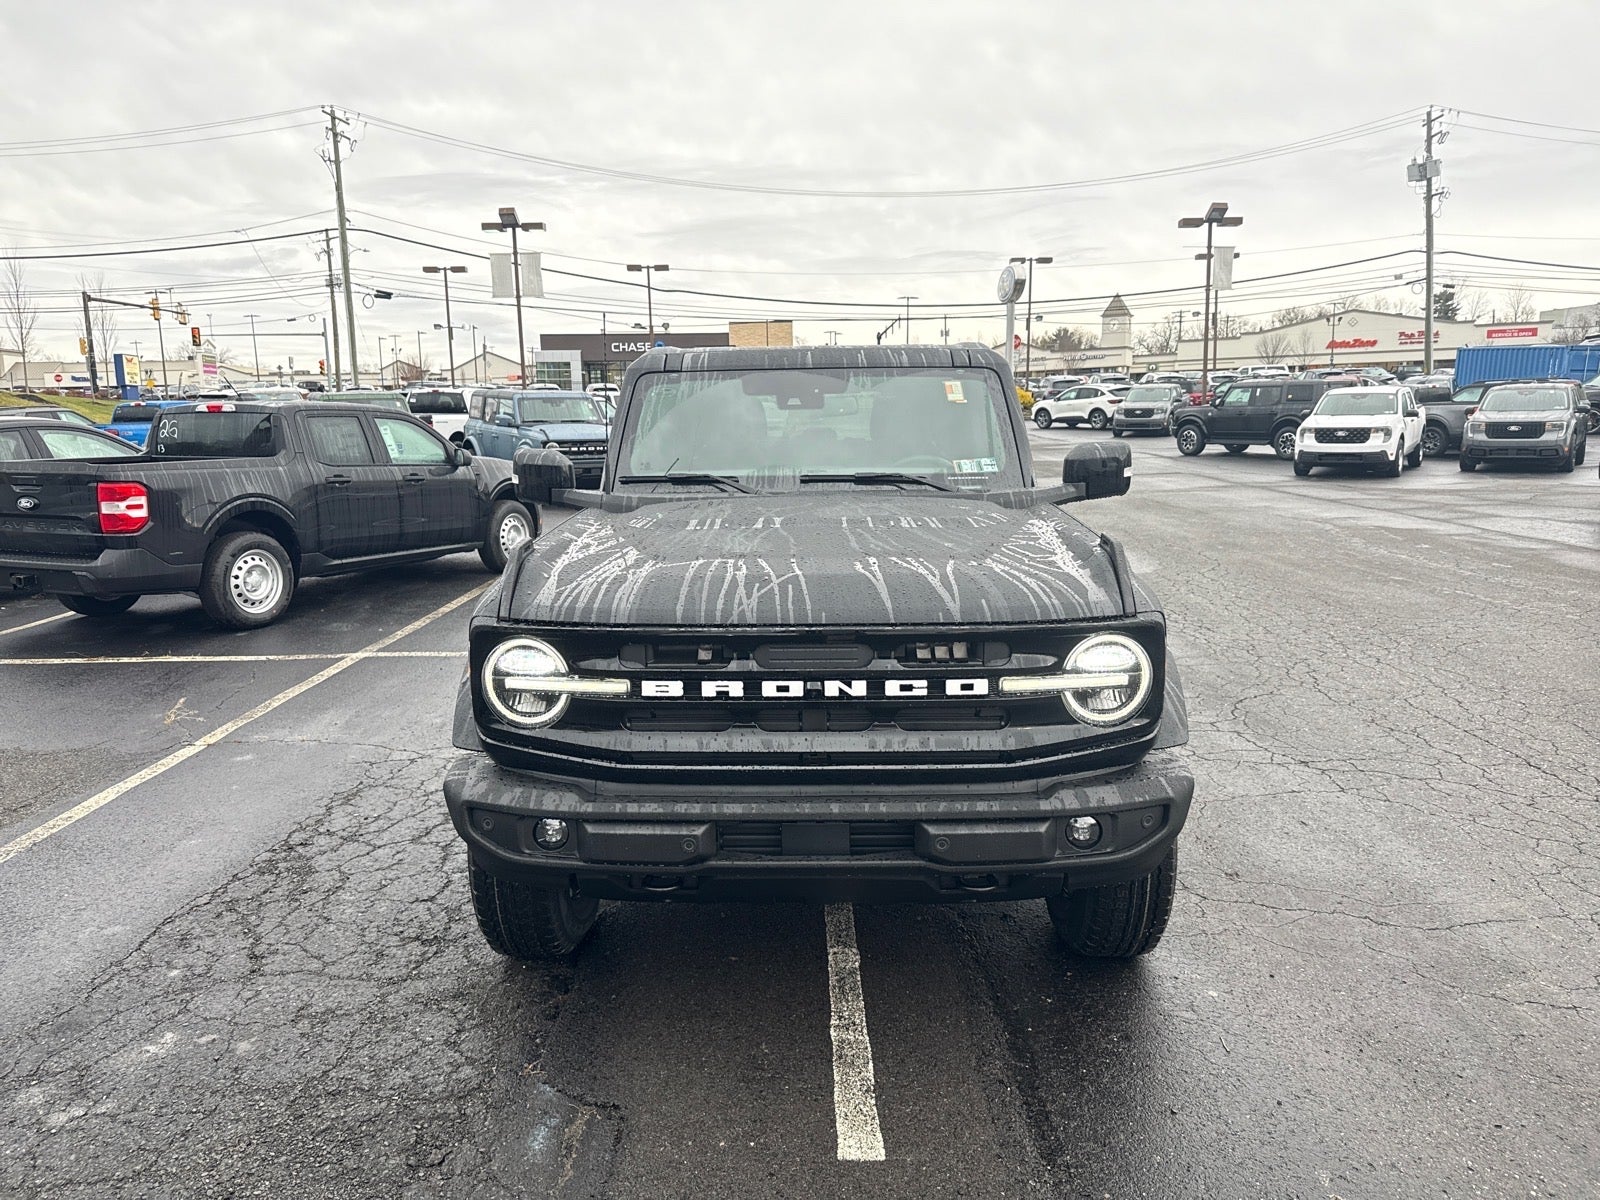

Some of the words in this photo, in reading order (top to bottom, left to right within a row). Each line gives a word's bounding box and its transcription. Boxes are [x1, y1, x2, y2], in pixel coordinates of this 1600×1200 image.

[611, 342, 651, 352] CHASE
[159, 419, 178, 439] 26
[0, 520, 84, 532] AVERICK
[641, 678, 989, 698] BRONCO
